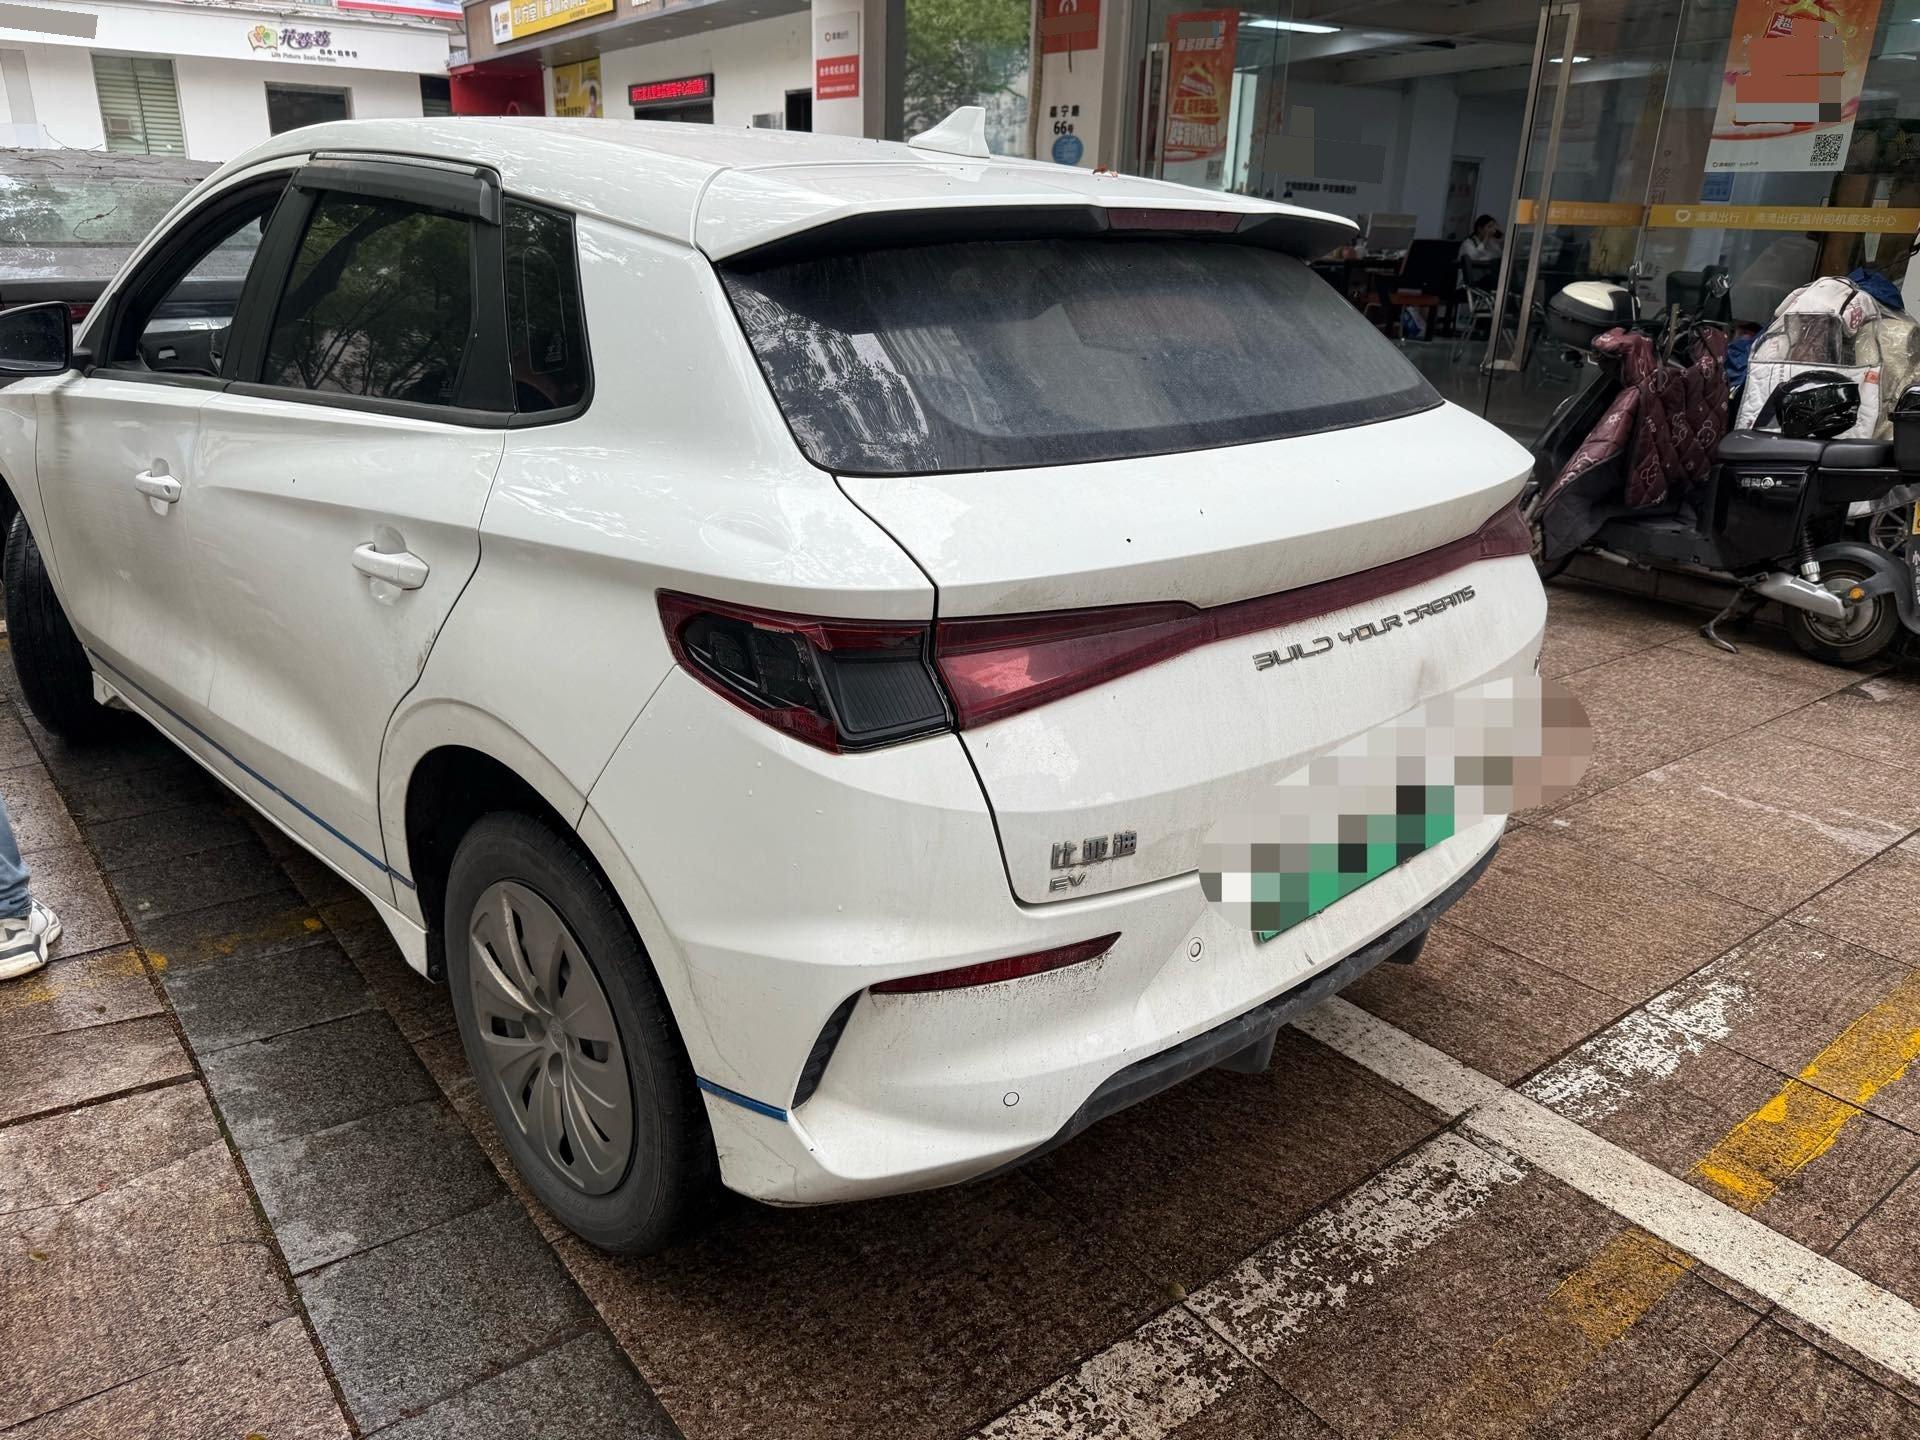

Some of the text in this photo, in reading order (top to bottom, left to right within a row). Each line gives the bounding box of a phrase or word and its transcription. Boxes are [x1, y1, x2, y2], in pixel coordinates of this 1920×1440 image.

[1252, 585, 1476, 671] BUILD YOUR DREAMS
[1050, 831, 1138, 870] 比亚迪
[1049, 872, 1086, 893] EV
